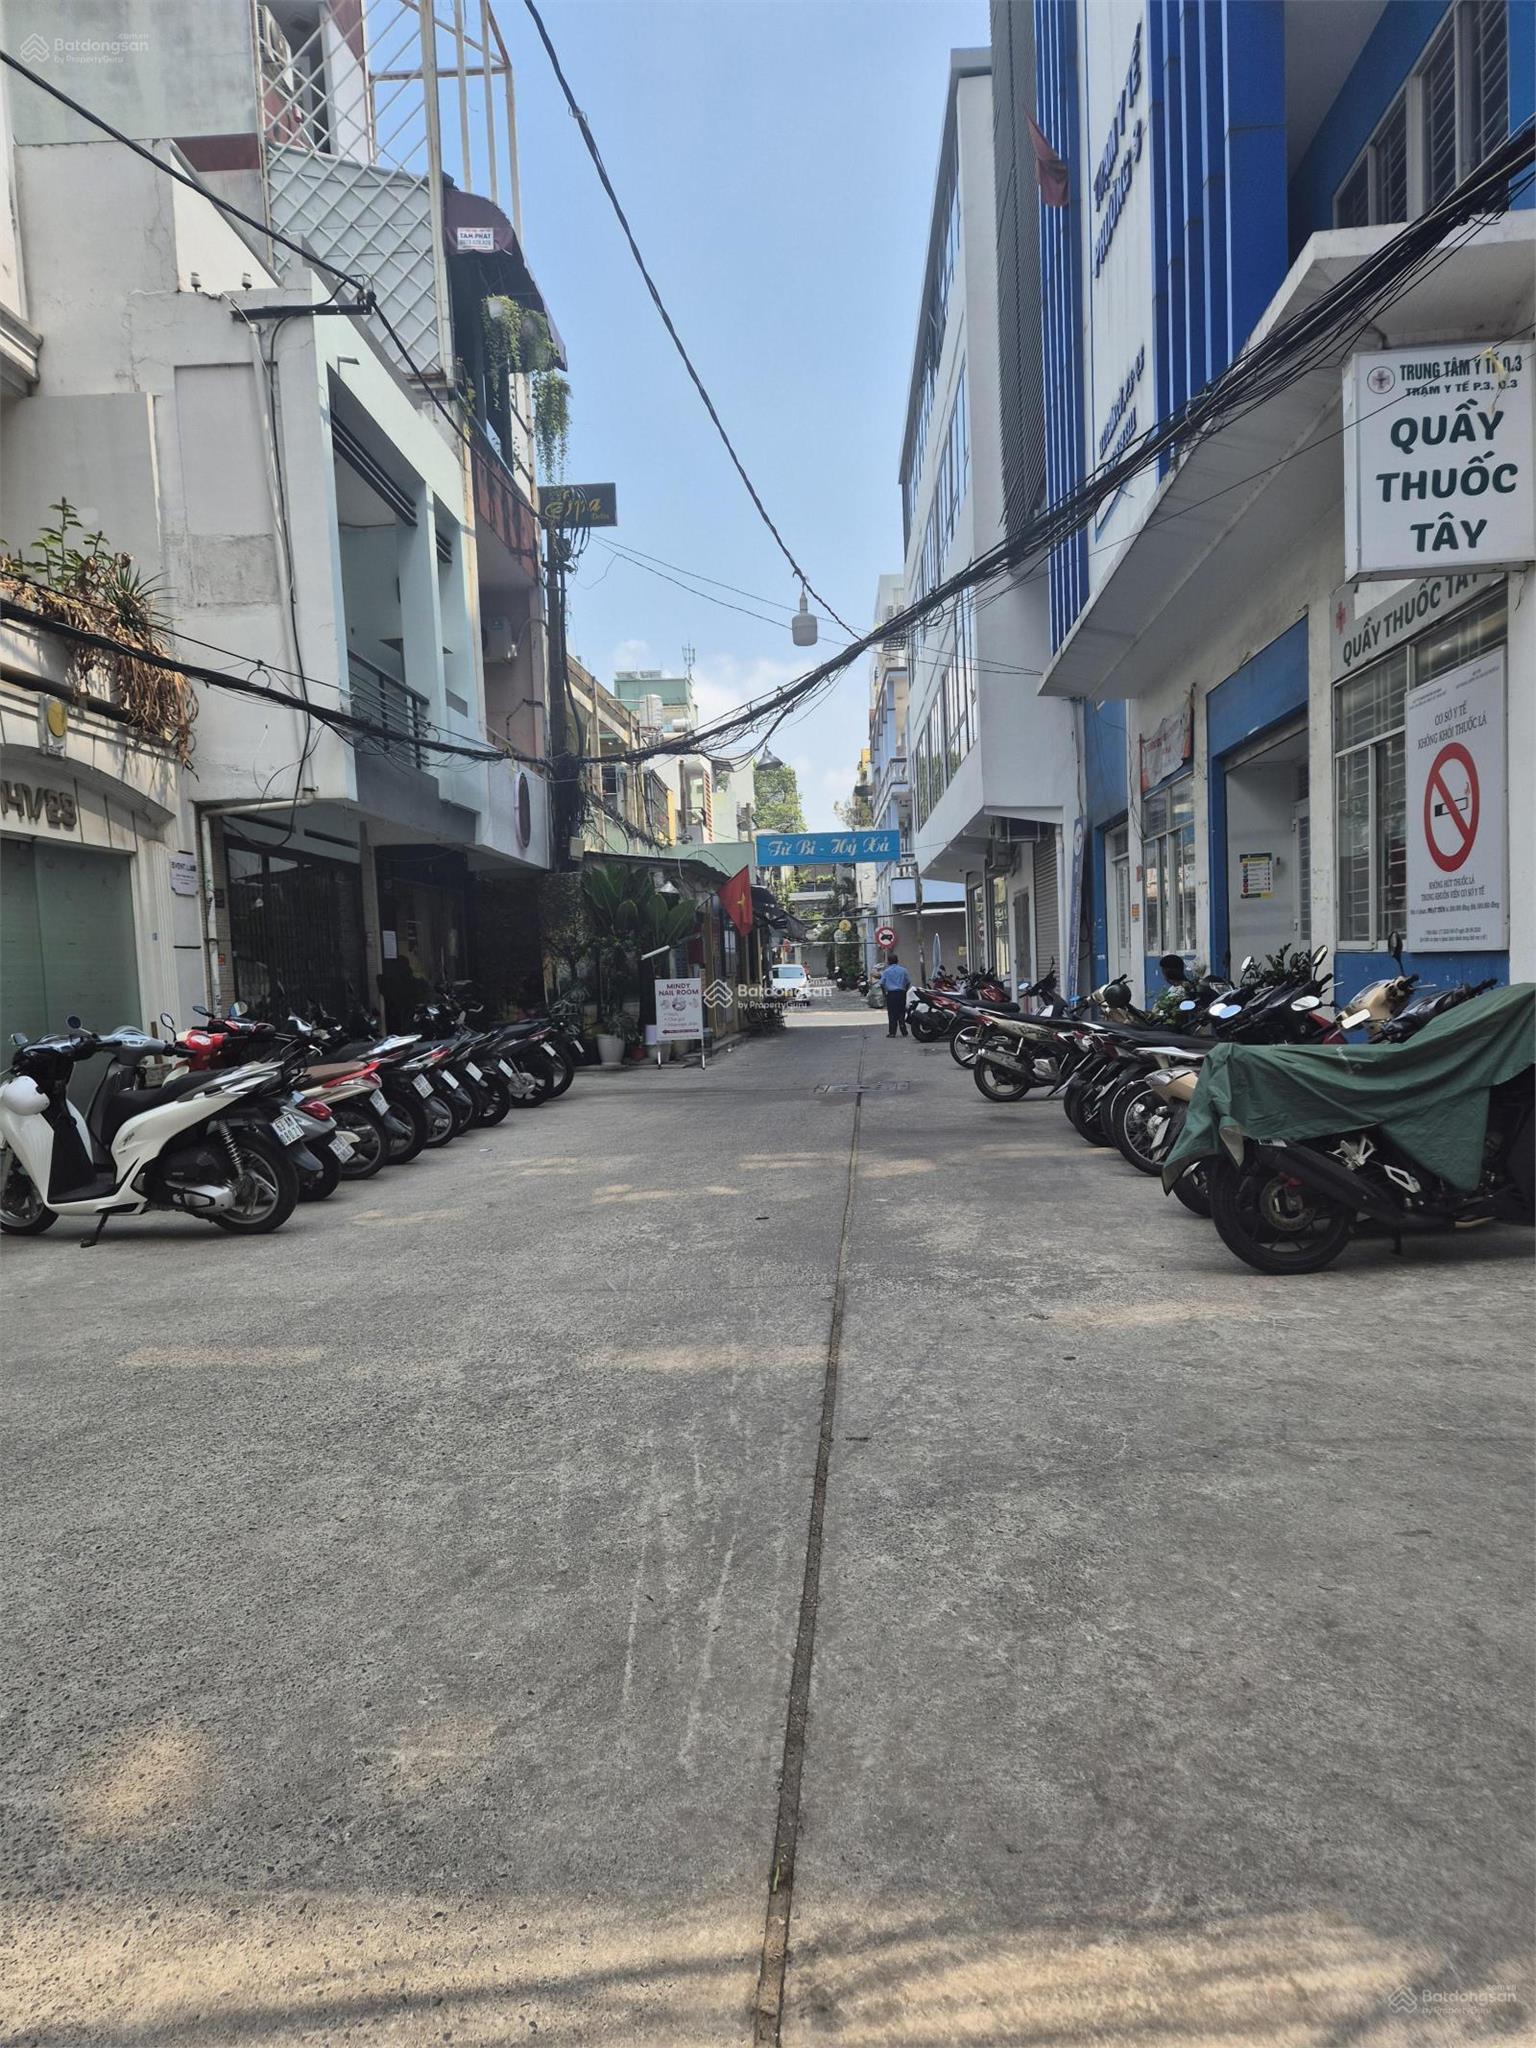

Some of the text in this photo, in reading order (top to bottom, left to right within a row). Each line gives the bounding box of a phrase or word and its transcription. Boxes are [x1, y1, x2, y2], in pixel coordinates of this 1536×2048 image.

[1400, 362, 1440, 381] TRUNG
[1444, 356, 1470, 377] TÂM
[1405, 385, 1440, 397] TRẠM
[1444, 385, 1452, 394] Y
[1455, 381, 1469, 392] TẾ
[1390, 398, 1504, 455] QUẦY
[1376, 450, 1518, 502] THUỐC
[1410, 511, 1488, 552] TÂY
[1343, 617, 1381, 667] QUẦY
[1384, 577, 1442, 638] THUỐC
